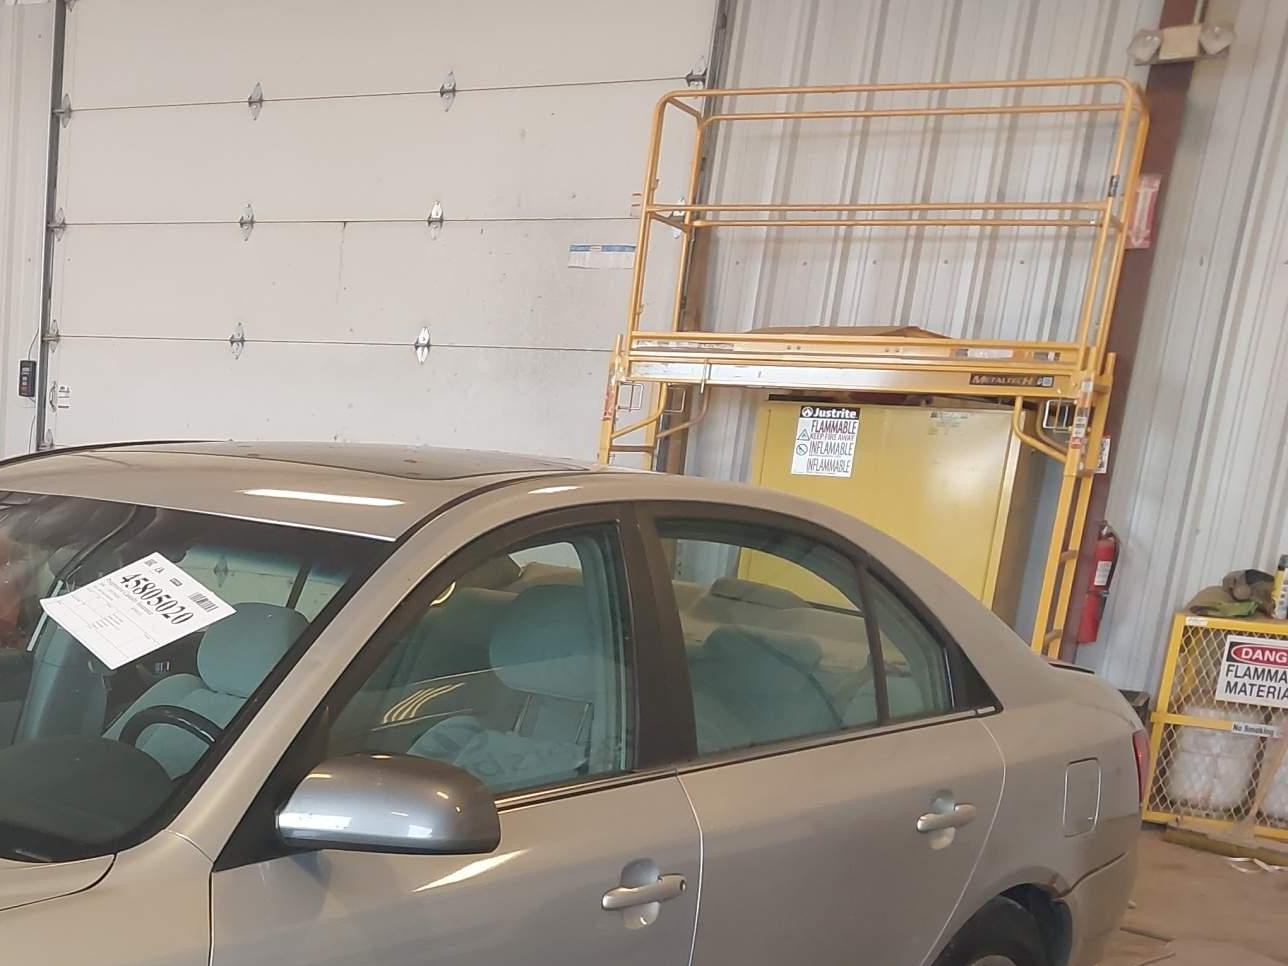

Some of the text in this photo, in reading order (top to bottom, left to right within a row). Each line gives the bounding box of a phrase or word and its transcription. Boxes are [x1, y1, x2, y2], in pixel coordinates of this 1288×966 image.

[813, 407, 857, 418] Justrite
[811, 419, 857, 434] FLAMMABLE
[809, 440, 854, 456] INFLAMABLE
[120, 572, 195, 625] 45805020
